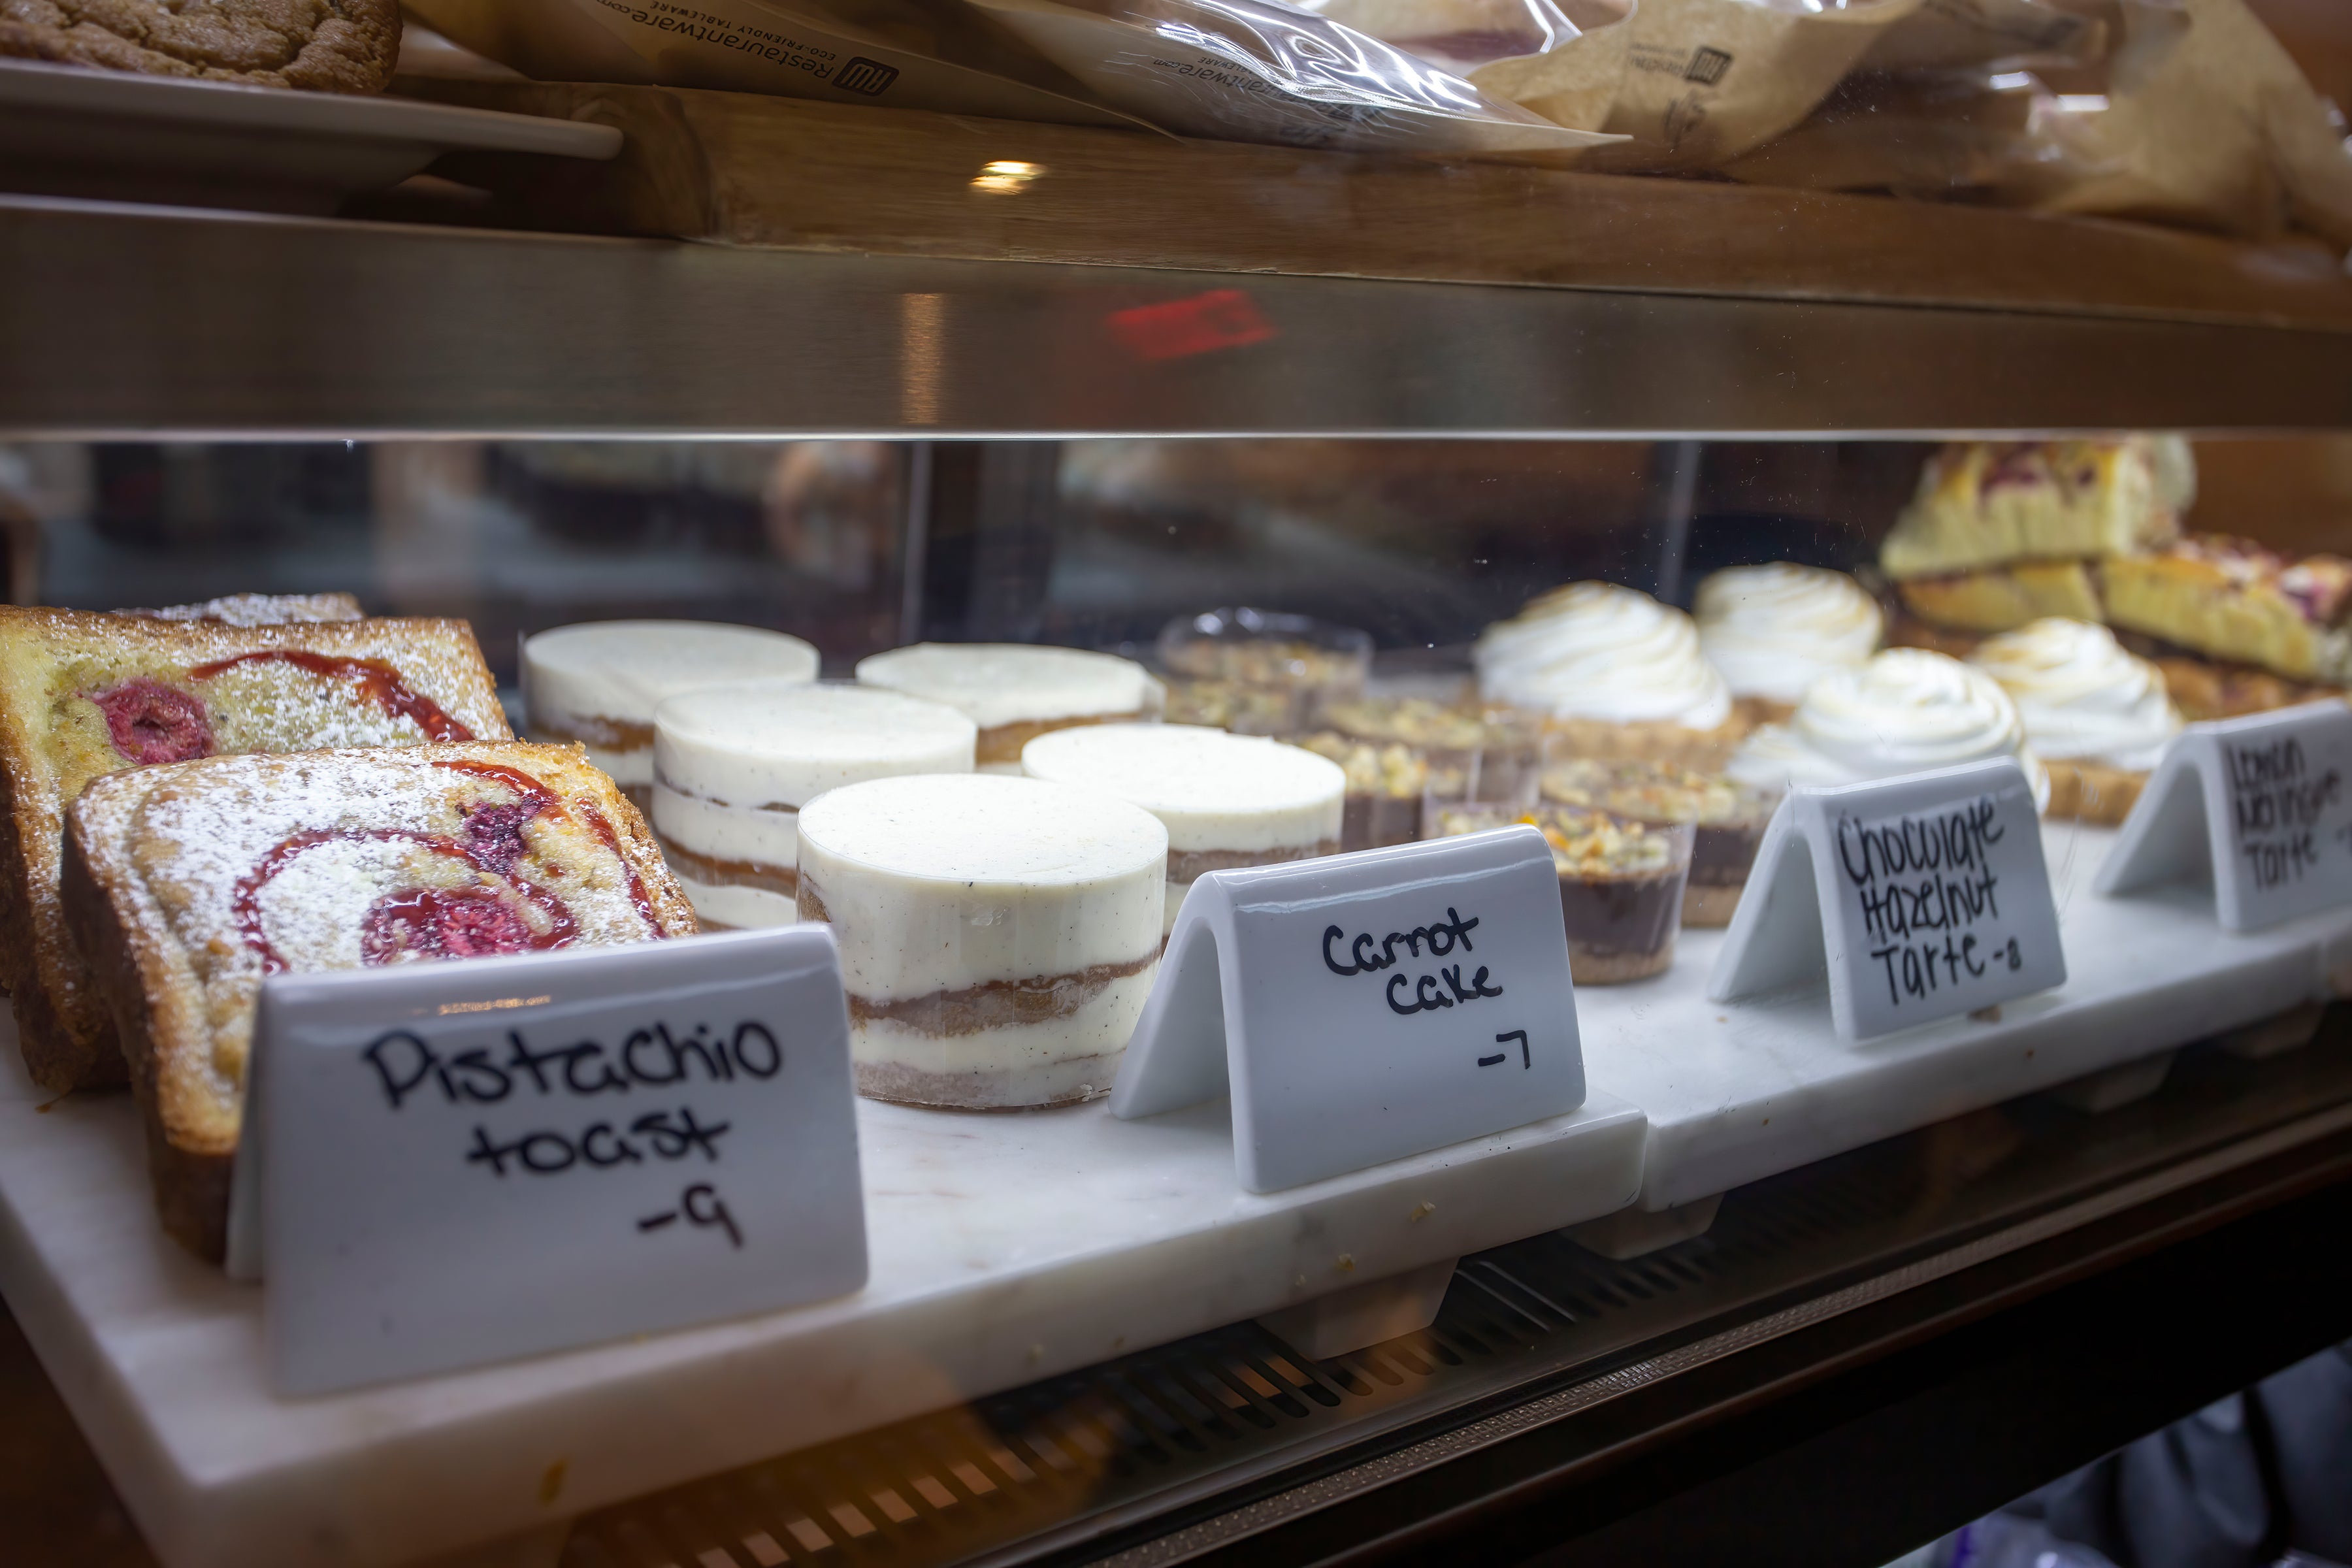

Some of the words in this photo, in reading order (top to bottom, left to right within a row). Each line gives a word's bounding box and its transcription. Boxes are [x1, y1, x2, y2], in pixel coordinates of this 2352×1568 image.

[649, 0, 732, 29] TABLEWARE
[737, 23, 836, 61] ECO-FRIENDLY
[1860, 864, 1998, 945] Hazelnut
[1323, 907, 1478, 975] Carrot
[1870, 928, 1985, 1005] Tarte
[465, 1107, 730, 1177] toast
